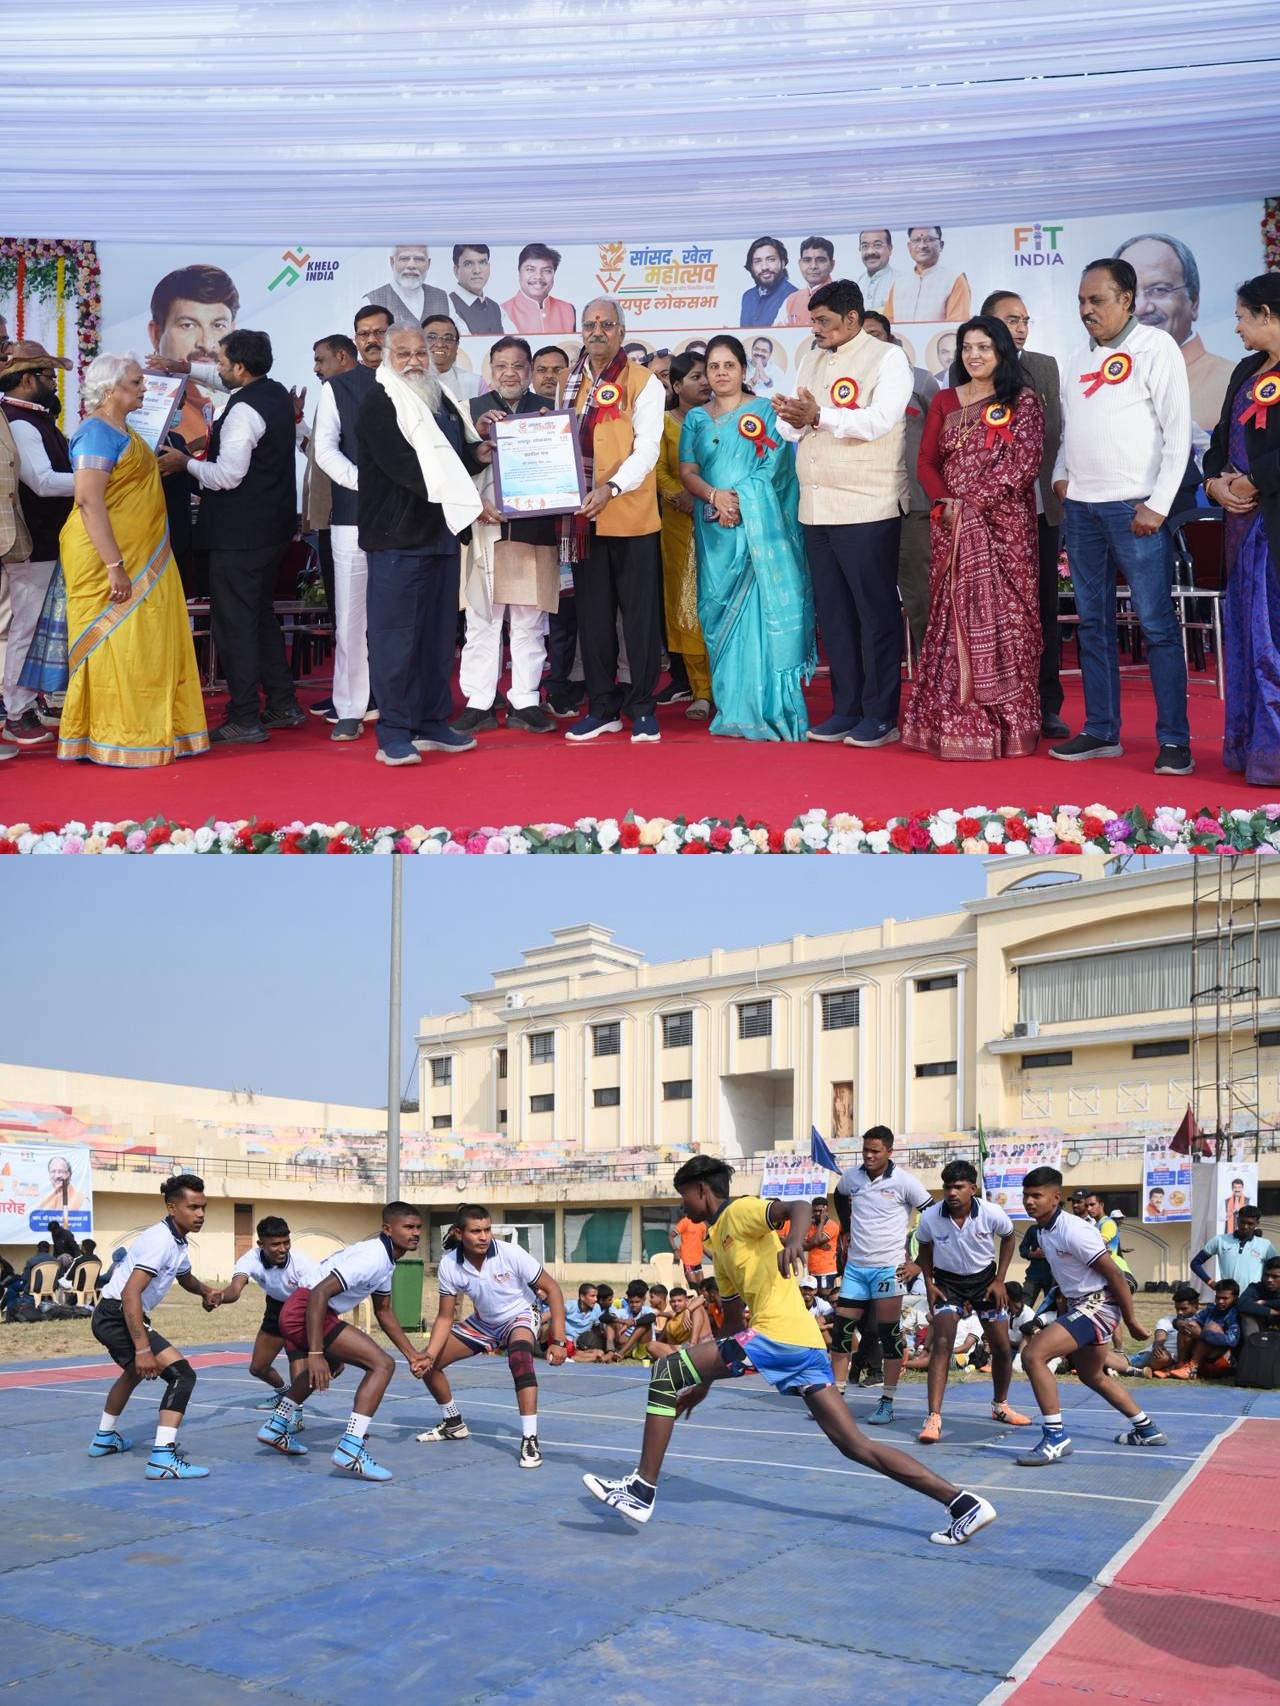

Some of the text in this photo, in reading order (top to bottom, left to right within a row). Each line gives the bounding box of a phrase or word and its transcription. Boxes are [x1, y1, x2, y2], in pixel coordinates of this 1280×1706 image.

[630, 245, 713, 266] सांसद खेल
[1014, 253, 1064, 267] INDIA
[307, 261, 340, 271] KHELO
[644, 259, 718, 285] महोत्सव
[305, 271, 334, 281] INDIA
[654, 293, 719, 310] लोकसभा
[0, 1198, 26, 1215] ारोह
[877, 1281, 890, 1293] 27
